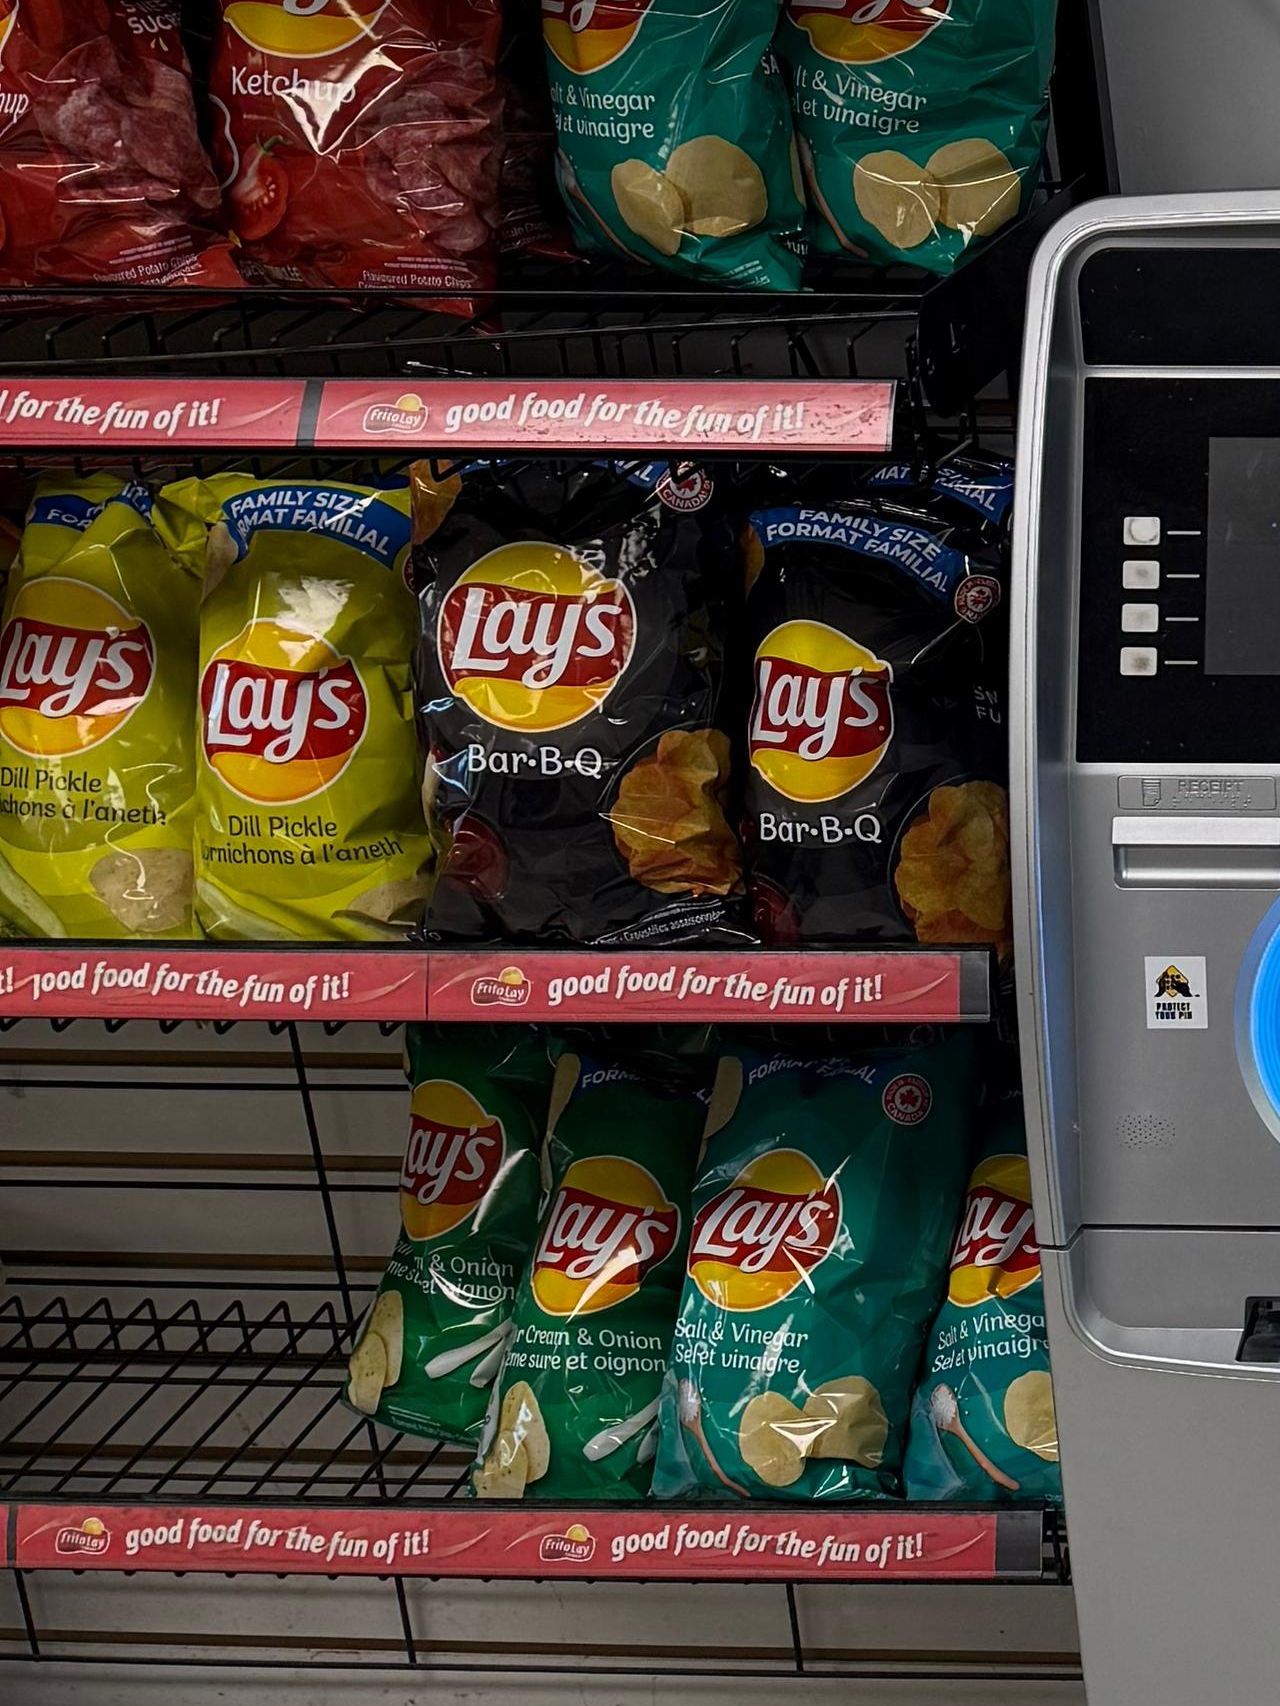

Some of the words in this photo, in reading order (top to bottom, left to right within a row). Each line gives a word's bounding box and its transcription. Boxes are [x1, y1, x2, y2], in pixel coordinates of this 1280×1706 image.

[231, 67, 358, 110] Ketchup
[566, 85, 577, 105] &
[579, 86, 656, 116] Vinegar
[812, 70, 827, 90] &
[836, 73, 927, 113] Vinegar
[577, 116, 655, 144] vinaigre
[803, 98, 818, 117] et
[824, 104, 920, 135] vinaigre
[7, 392, 52, 424] for
[54, 398, 99, 427] the
[100, 401, 146, 435] fun
[153, 405, 183, 437] of
[188, 399, 221, 426] it!
[445, 394, 515, 433] good
[517, 392, 586, 426] food
[584, 394, 630, 427] for
[634, 400, 682, 429] the
[681, 404, 731, 437] fun
[737, 406, 769, 440] of
[773, 402, 804, 432] it!
[231, 490, 312, 519] FAMILY
[313, 492, 366, 519] SIZE
[292, 510, 390, 556] FAMILIAL
[799, 509, 888, 537] FAMILY
[889, 528, 941, 562] SIZE
[766, 522, 863, 545] FORMAT
[863, 539, 948, 592] FAMILIAL
[451, 587, 623, 690] Lay's
[2, 623, 145, 718] Lay's
[207, 664, 353, 763] Lay's
[751, 661, 879, 761] Lay's
[1, 767, 29, 789] Dill
[36, 769, 101, 793] Pickle
[83, 798, 166, 825] l'aneth
[228, 814, 262, 838] Dill
[270, 816, 338, 839] Pickle
[300, 842, 316, 865] à
[322, 837, 404, 864] l'aneth
[91, 962, 150, 995] food
[152, 964, 192, 995] for
[196, 970, 239, 999] the
[240, 975, 284, 1007] fun
[289, 976, 315, 1010] of
[322, 973, 349, 1001] it!
[548, 967, 611, 1006] good
[615, 965, 676, 999] food
[678, 967, 719, 999] for
[724, 973, 766, 1001] the
[769, 977, 816, 1010] fun
[821, 980, 849, 1012] of
[854, 974, 883, 1003] it!
[537, 1190, 670, 1278] Lay's
[695, 1179, 832, 1270] Lay's
[429, 1254, 445, 1273] &
[450, 1256, 514, 1278] Onion
[525, 1324, 570, 1346] Cream
[577, 1328, 593, 1347] &
[598, 1329, 662, 1351] Onion
[675, 1317, 707, 1340] Salt
[711, 1321, 724, 1341] &
[732, 1322, 808, 1352] Vinegar
[527, 1351, 560, 1371] sure
[566, 1352, 588, 1371] et
[594, 1353, 666, 1377] oignon
[721, 1349, 800, 1377] vinaigre
[125, 1519, 183, 1555] good
[188, 1518, 243, 1550] food
[244, 1519, 282, 1551] for
[286, 1527, 325, 1554] the
[326, 1531, 368, 1563] fun
[373, 1532, 398, 1564] of
[403, 1529, 430, 1556] it!
[611, 1525, 670, 1563] good
[674, 1524, 731, 1556] food
[732, 1526, 772, 1556] for
[776, 1532, 813, 1559] the
[817, 1536, 860, 1566] fun
[865, 1537, 892, 1569] of
[896, 1533, 923, 1560] it!
